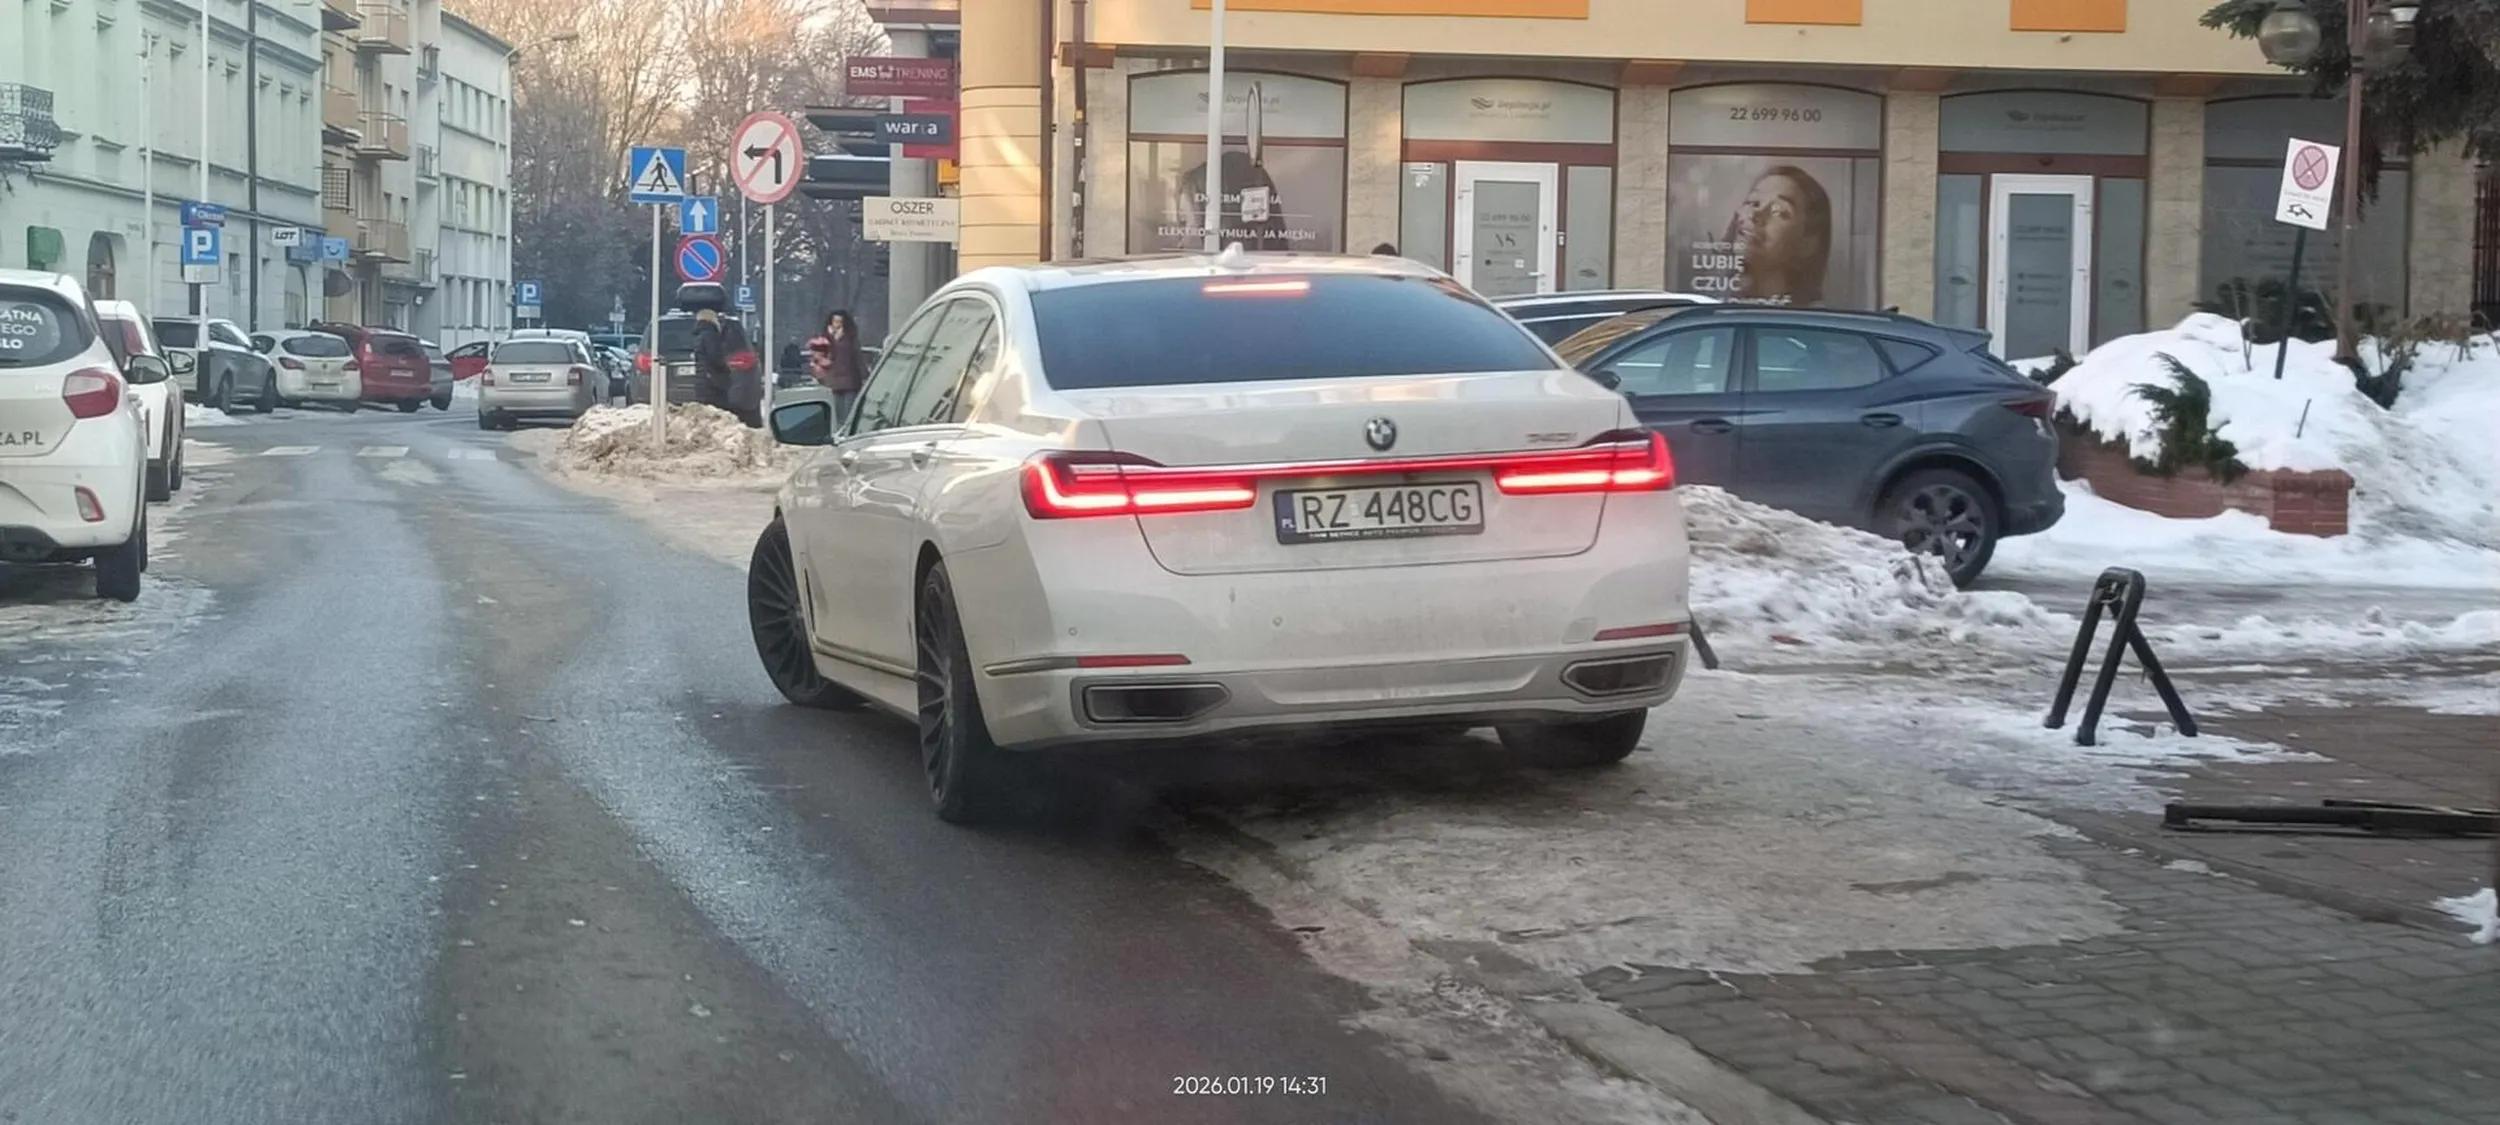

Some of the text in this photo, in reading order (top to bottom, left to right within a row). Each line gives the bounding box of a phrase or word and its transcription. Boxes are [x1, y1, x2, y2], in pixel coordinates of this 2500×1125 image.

[850, 66, 949, 79] EMS TRENING
[1730, 107, 1822, 122] 22 699 96 00
[890, 201, 934, 214] OSZER
[274, 231, 297, 240] LOT
[1692, 254, 1745, 273] LUBIĘ
[1691, 273, 1741, 291] CZUĆ
[0, 338, 24, 349] LO
[1281, 488, 1472, 530] PL RZ 448CG
